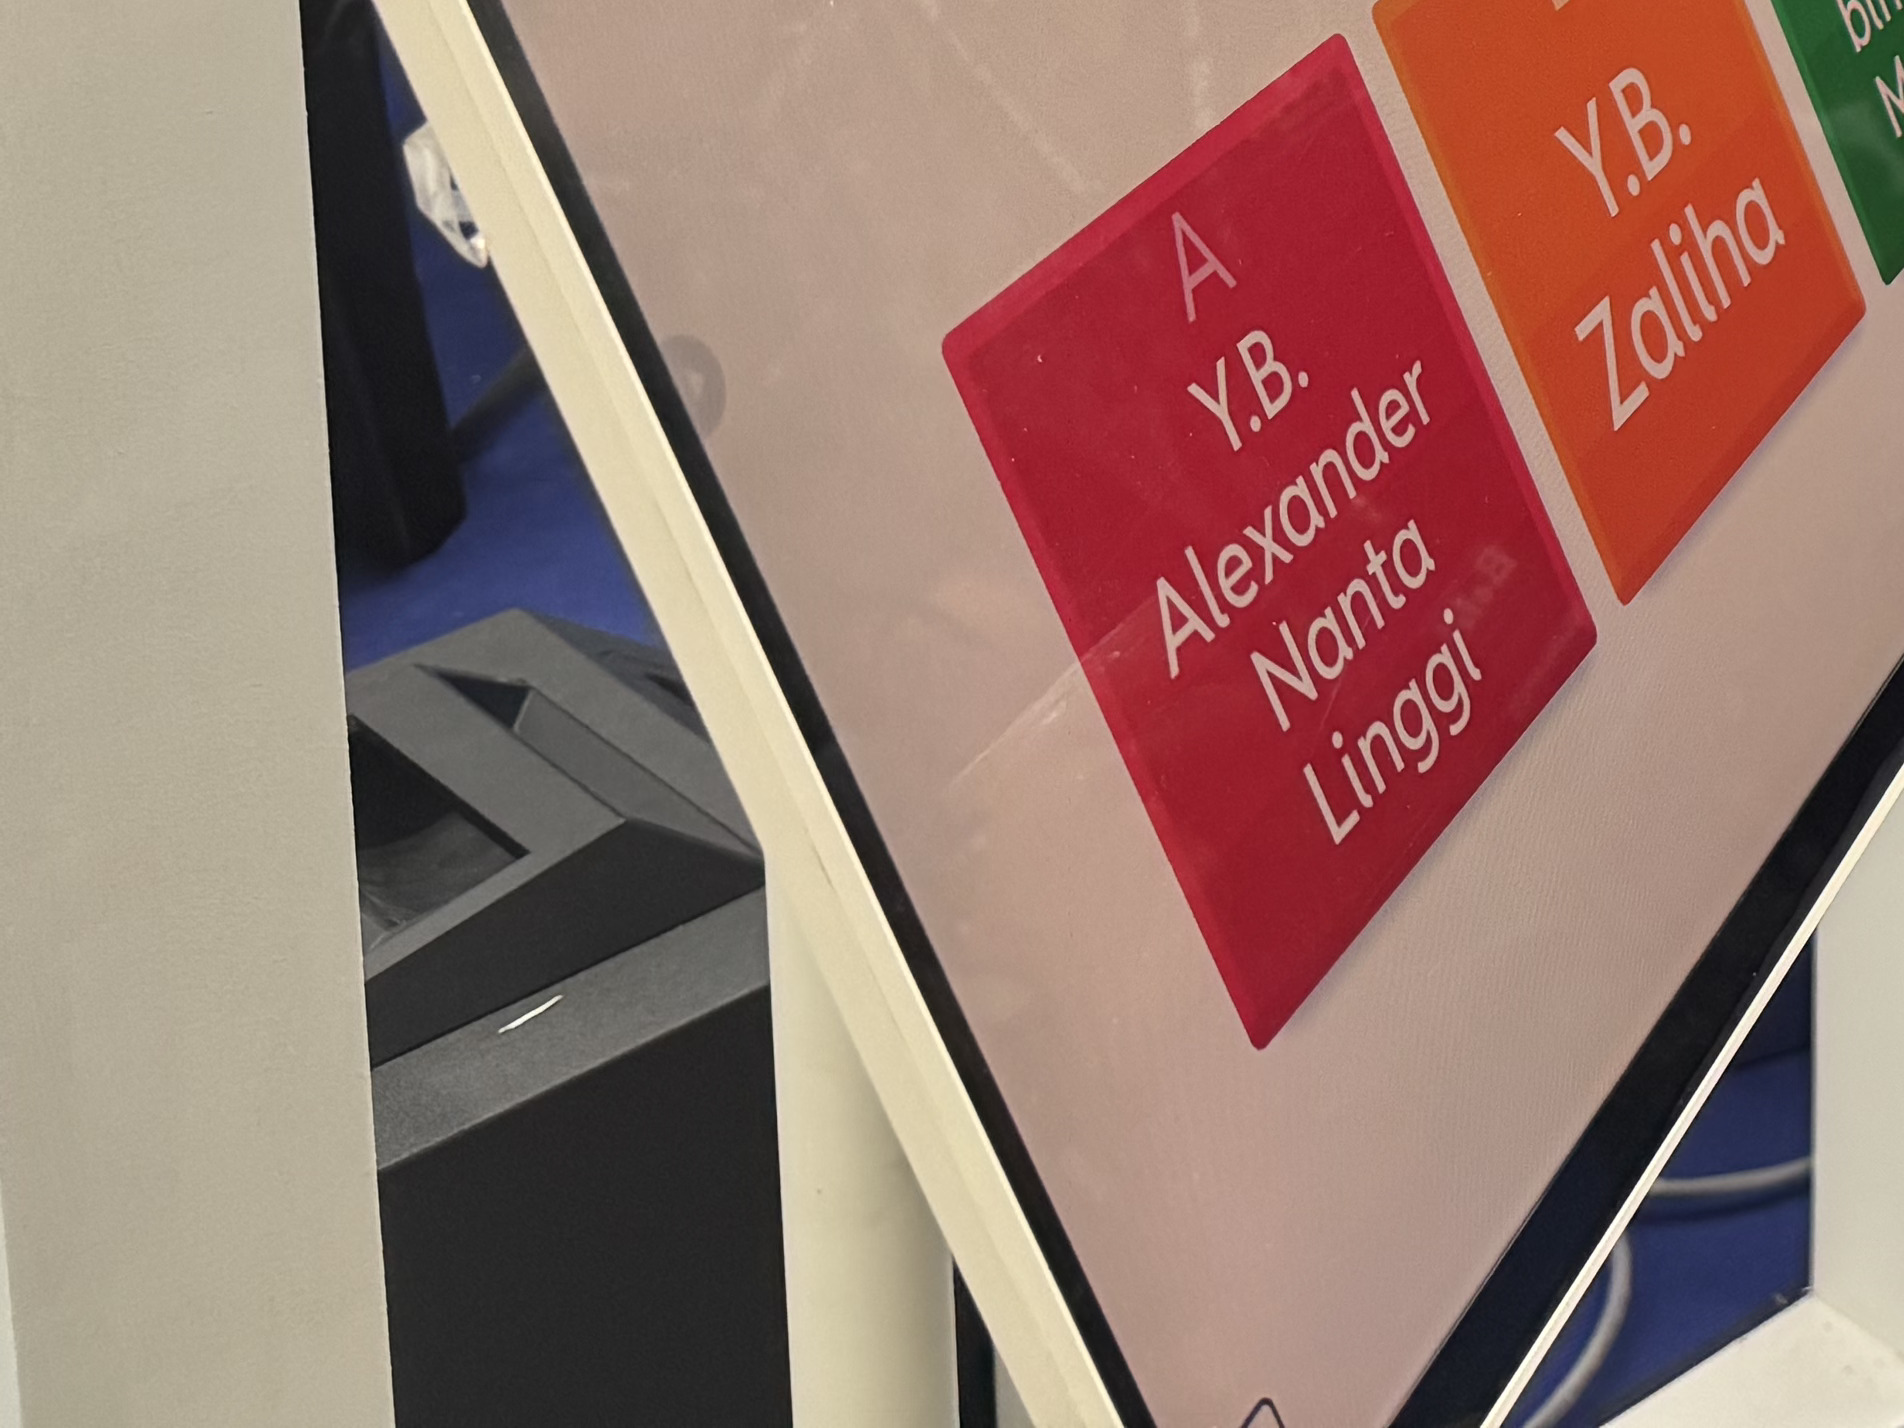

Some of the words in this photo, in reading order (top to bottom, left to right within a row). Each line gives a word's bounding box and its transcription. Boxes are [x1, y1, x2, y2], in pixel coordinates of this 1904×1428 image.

[1555, 65, 1692, 219] Y.B.
[1171, 210, 1238, 323] A
[1574, 176, 1786, 432] Zaliha
[1188, 327, 1310, 452] Y.B.
[1153, 359, 1435, 680] Alexander
[1250, 518, 1436, 733] Nanta
[1303, 607, 1483, 845] Linggi
